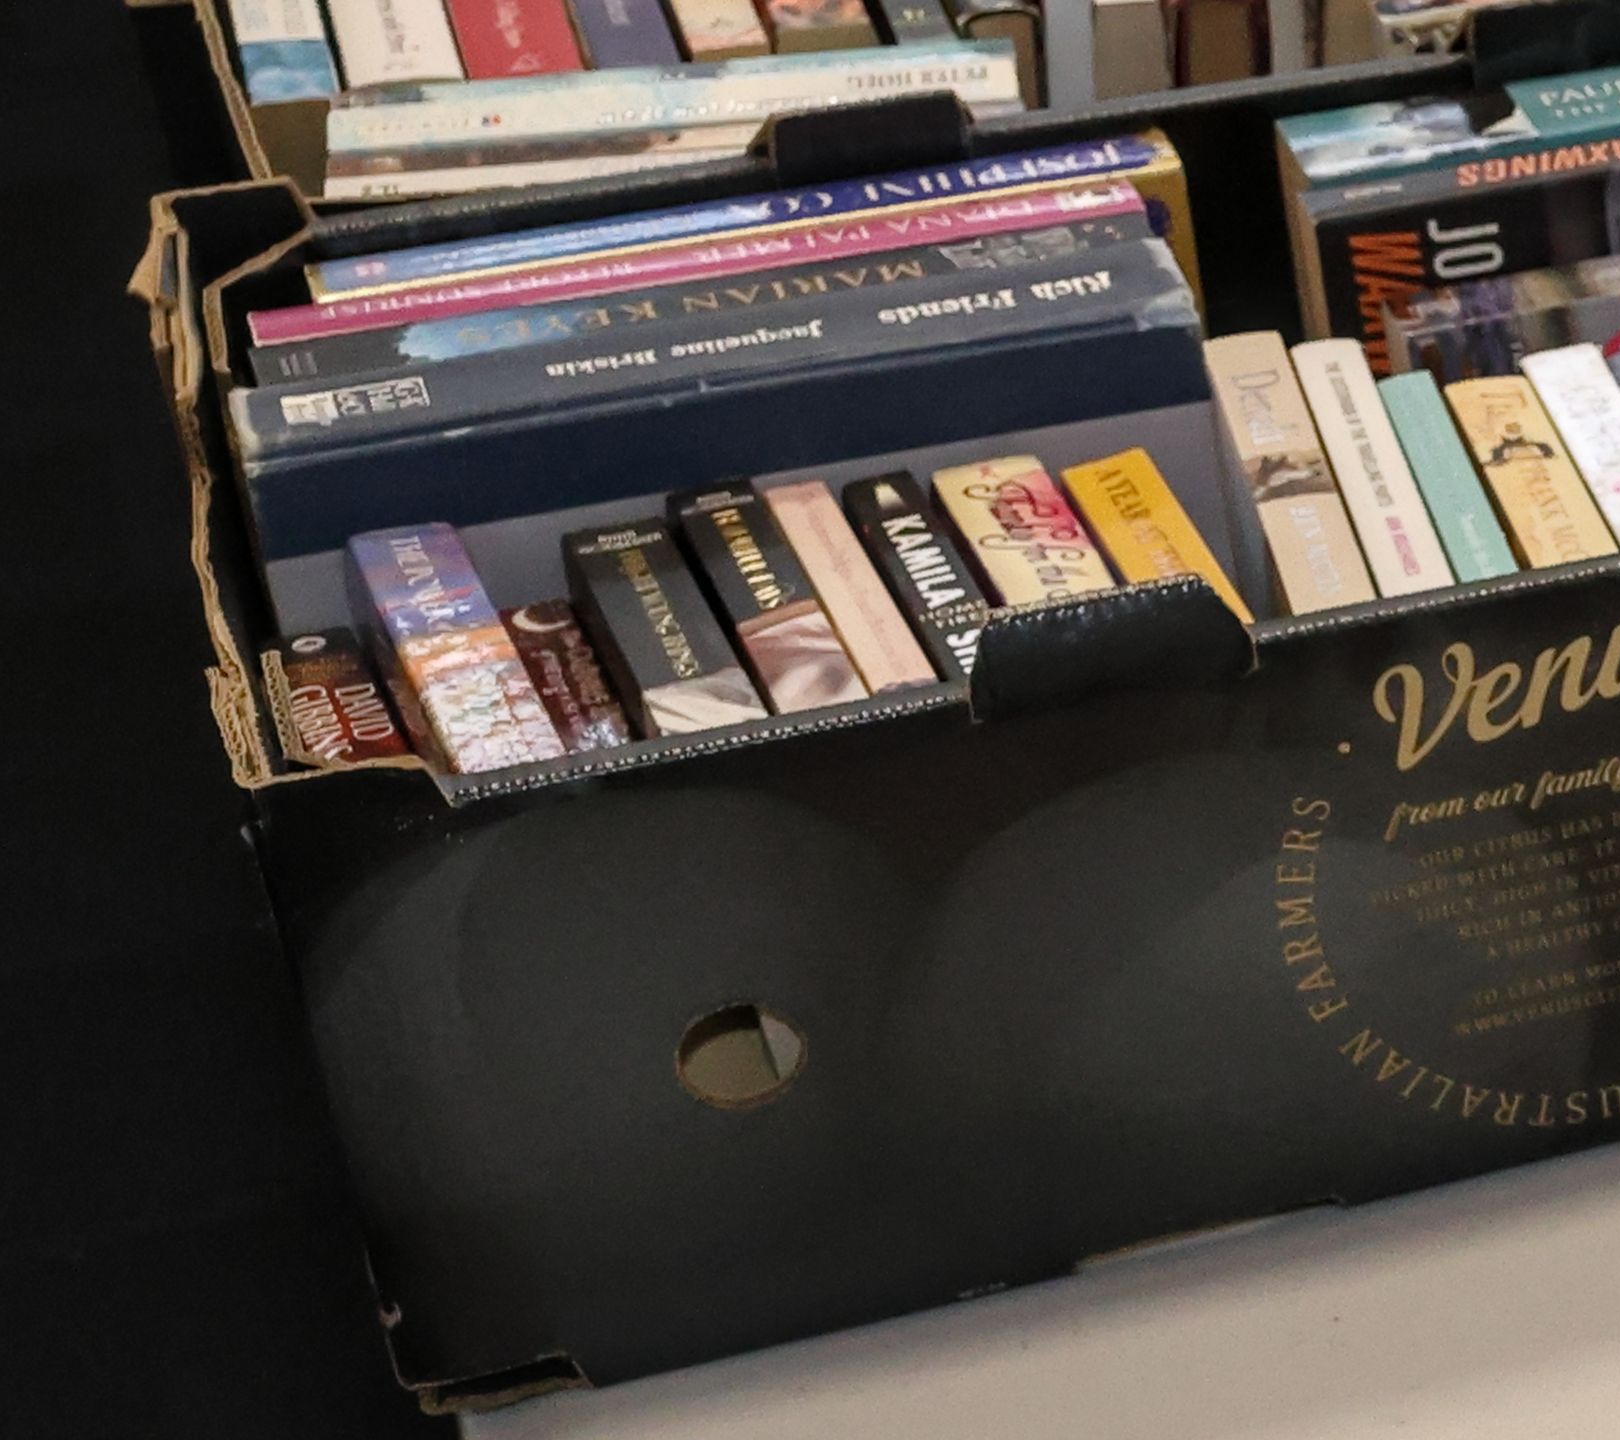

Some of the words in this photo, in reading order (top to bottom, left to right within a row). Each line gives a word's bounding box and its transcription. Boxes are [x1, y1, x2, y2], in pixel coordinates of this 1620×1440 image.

[680, 257, 925, 313] MARIAN
[875, 285, 1016, 328] Friends
[1031, 270, 1111, 308] Rich
[882, 514, 967, 611] KAMILA
[1383, 796, 1467, 843] from
[1472, 781, 1527, 812] our
[1277, 795, 1350, 1022] FARMERS
